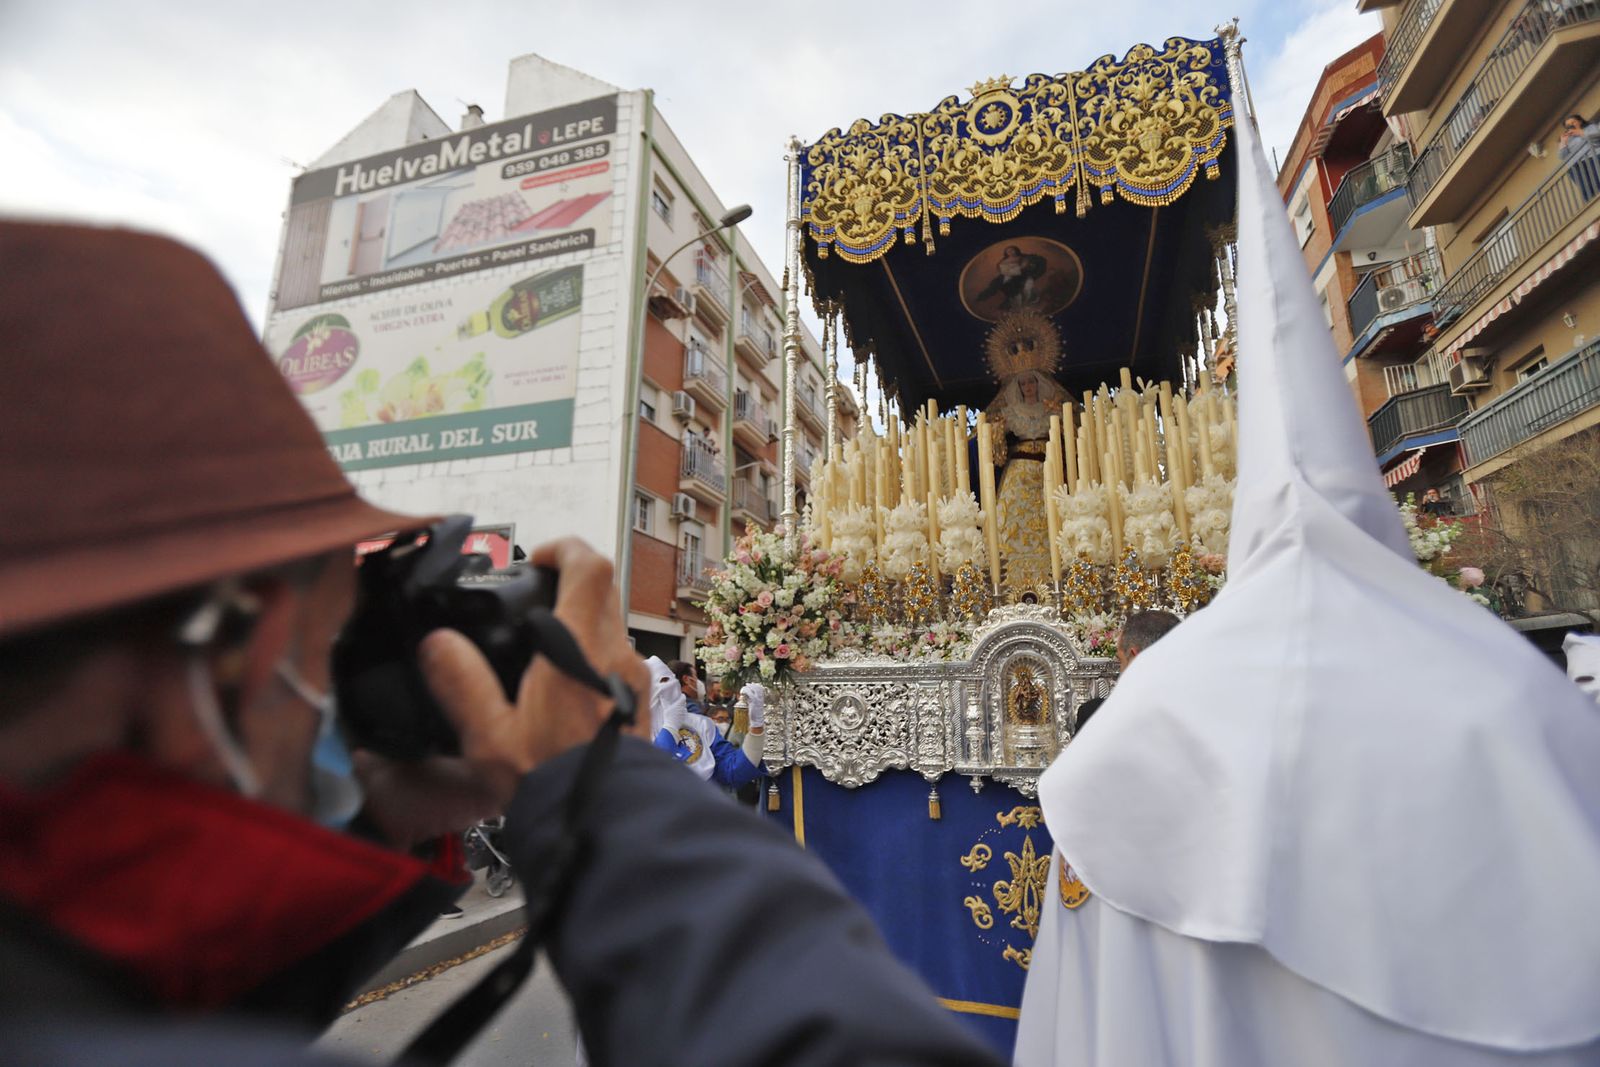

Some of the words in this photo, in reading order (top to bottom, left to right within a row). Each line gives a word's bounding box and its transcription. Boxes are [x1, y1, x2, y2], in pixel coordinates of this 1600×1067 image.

[335, 123, 532, 197] HuelvaMetal
[552, 116, 604, 143] LEPE
[505, 160, 536, 178] 959
[539, 151, 570, 169] 040
[574, 143, 606, 161] 385
[435, 256, 481, 275] Puertas
[492, 247, 526, 263] Panel
[528, 232, 589, 256] Sandwich
[327, 442, 363, 463] AJA
[366, 433, 434, 458] RURAL
[439, 427, 484, 449] DEL
[491, 420, 538, 444] SUR
